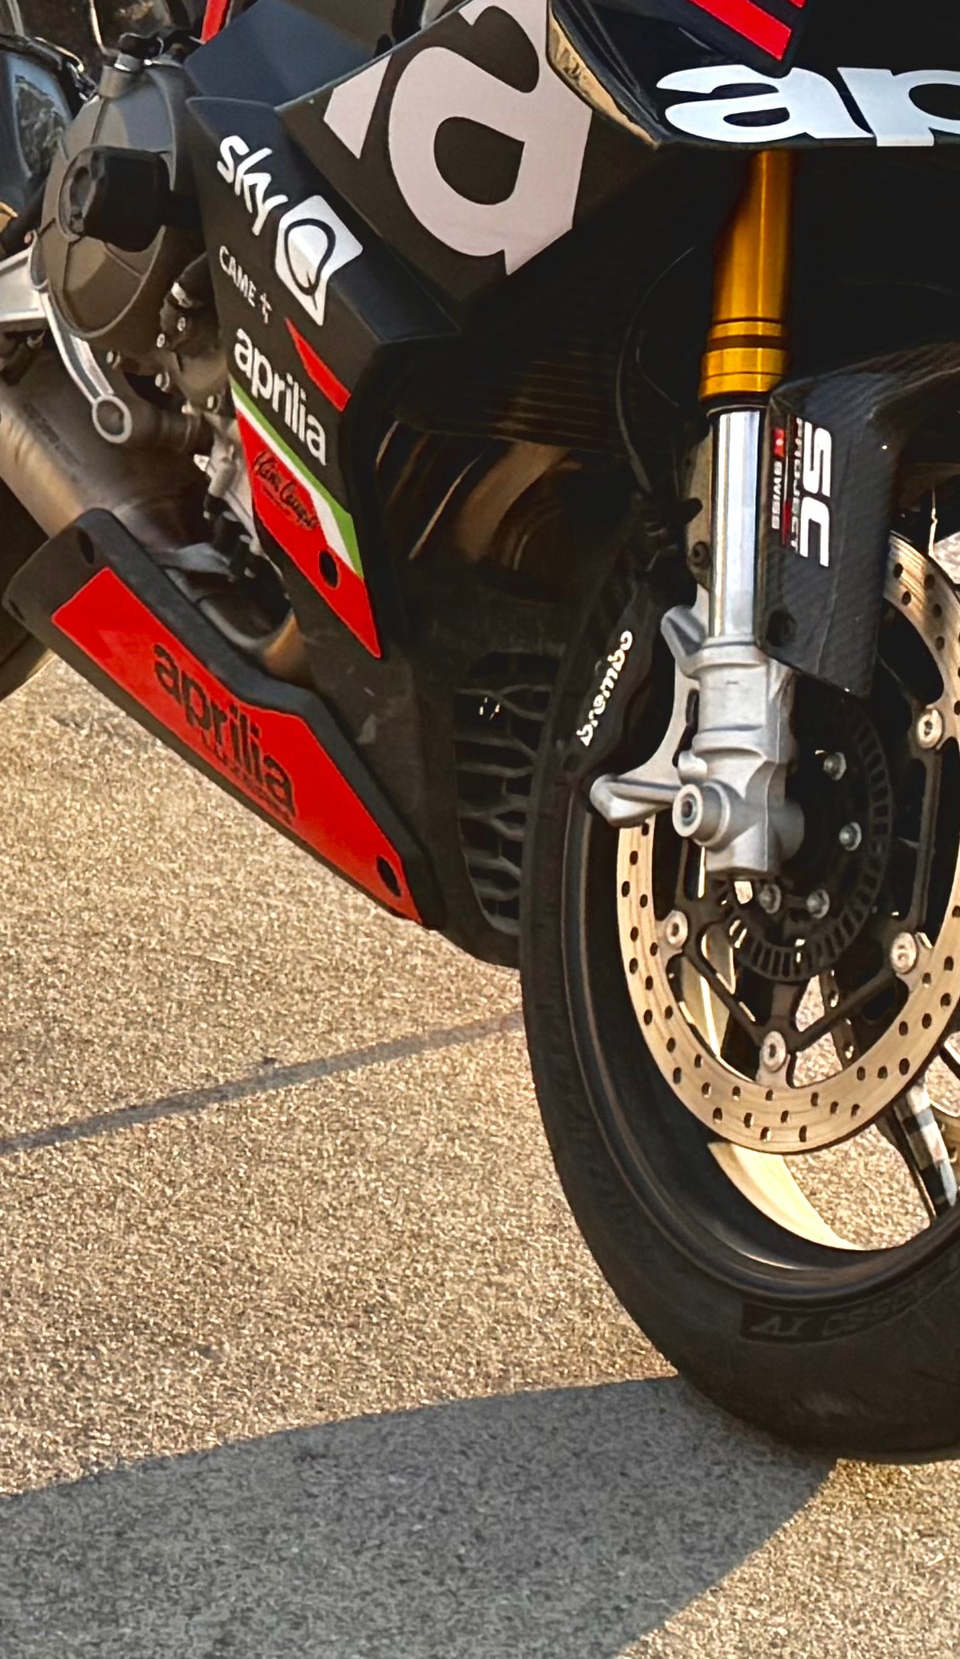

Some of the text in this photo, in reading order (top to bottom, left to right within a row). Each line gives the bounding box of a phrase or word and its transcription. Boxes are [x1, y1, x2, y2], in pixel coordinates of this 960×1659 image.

[216, 135, 289, 236] sky
[233, 327, 327, 466] aprilia
[799, 420, 832, 568] SC
[153, 643, 296, 818] aprilia
[577, 630, 633, 746] brembo
